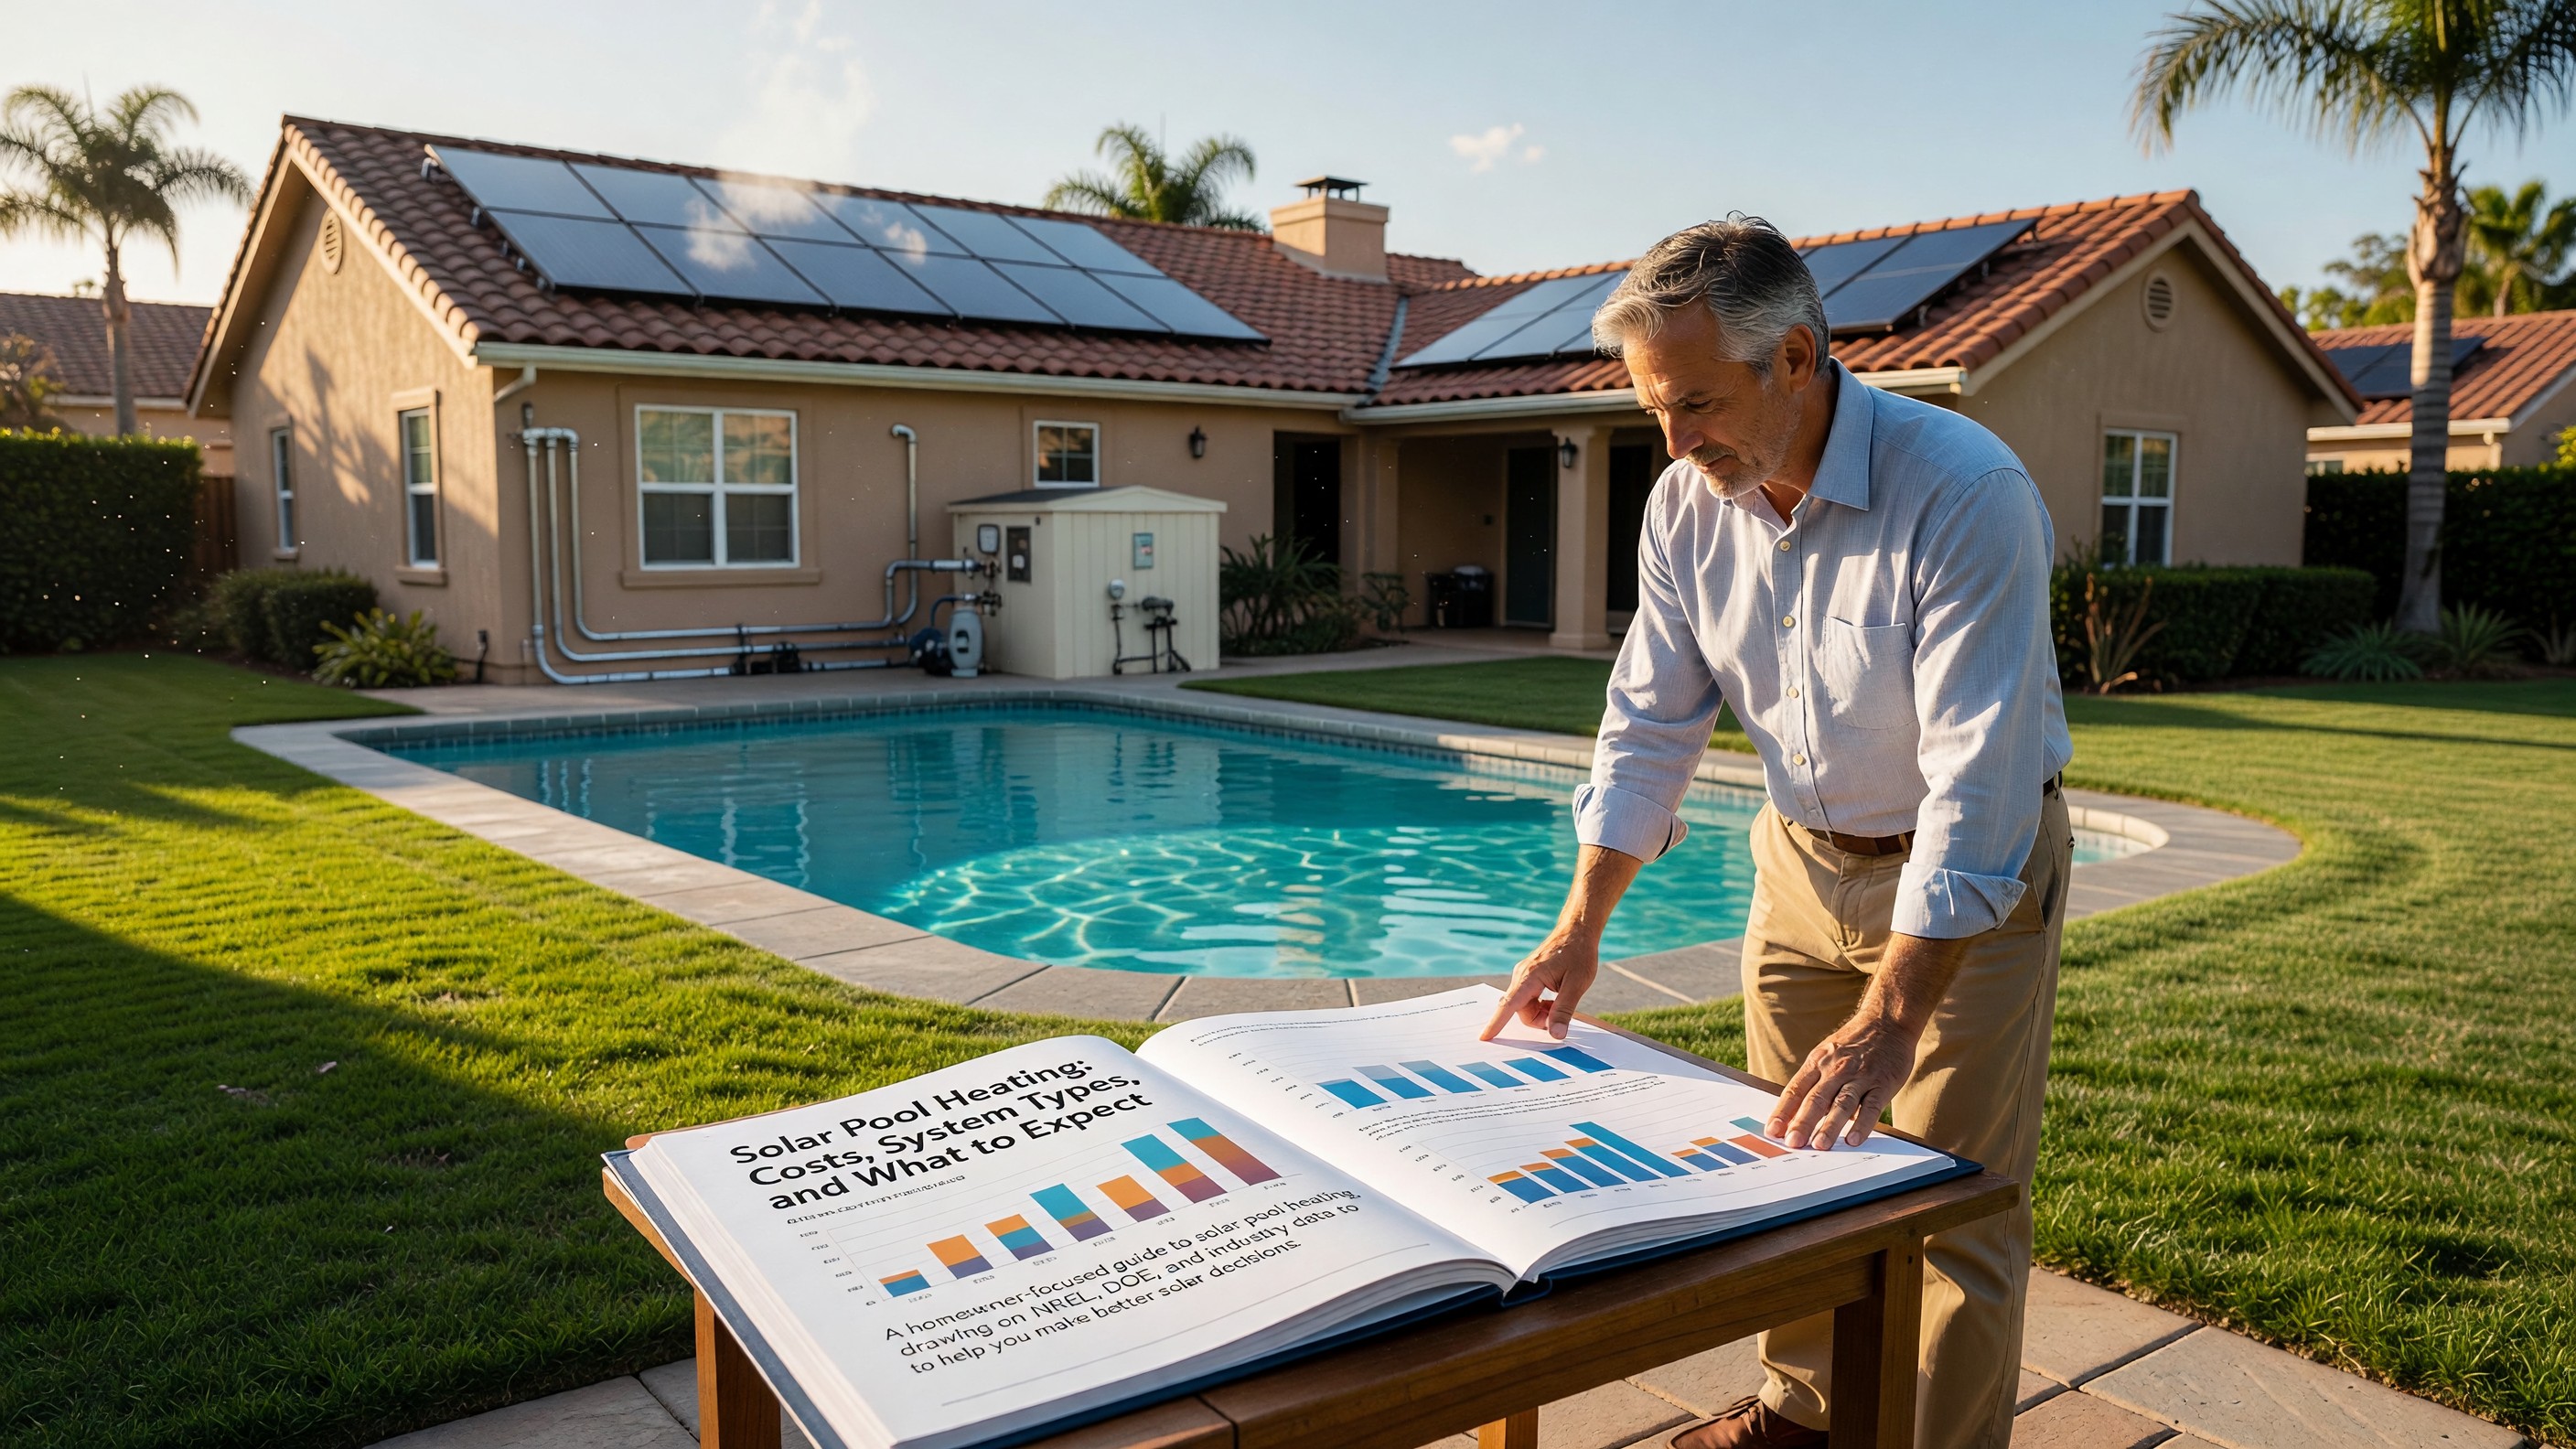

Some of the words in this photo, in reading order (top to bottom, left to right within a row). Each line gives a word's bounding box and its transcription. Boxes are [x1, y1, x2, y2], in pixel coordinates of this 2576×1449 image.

[730, 1131, 832, 1164] Solar
[840, 1100, 931, 1137] Pool
[933, 1060, 1093, 1111] Heating:
[749, 1151, 874, 1186] Costs,
[878, 1106, 1019, 1154] System
[1017, 1075, 1141, 1111] Types,
[769, 1175, 851, 1209] and
[852, 1147, 969, 1187] What
[971, 1135, 1015, 1154] to
[1019, 1093, 1153, 1140] Expect
[886, 1327, 904, 1341] A
[1113, 1248, 1168, 1273] guide
[1168, 1238, 1192, 1251] to
[1195, 1219, 1240, 1242] solar
[1244, 1205, 1285, 1228] pool
[900, 1323, 994, 1357] drawing
[997, 1314, 1026, 1328] on
[1030, 1290, 1103, 1318] NREL,
[1101, 1268, 1162, 1294] DOE,
[1165, 1250, 1205, 1273] and
[1293, 1210, 1336, 1228] data
[1336, 1202, 1359, 1214] to
[910, 1360, 934, 1374] to
[938, 1347, 986, 1369] help
[989, 1332, 1031, 1354] you
[1035, 1314, 1091, 1337] make
[1090, 1291, 1154, 1318] better
[1158, 1274, 1205, 1297] solar
